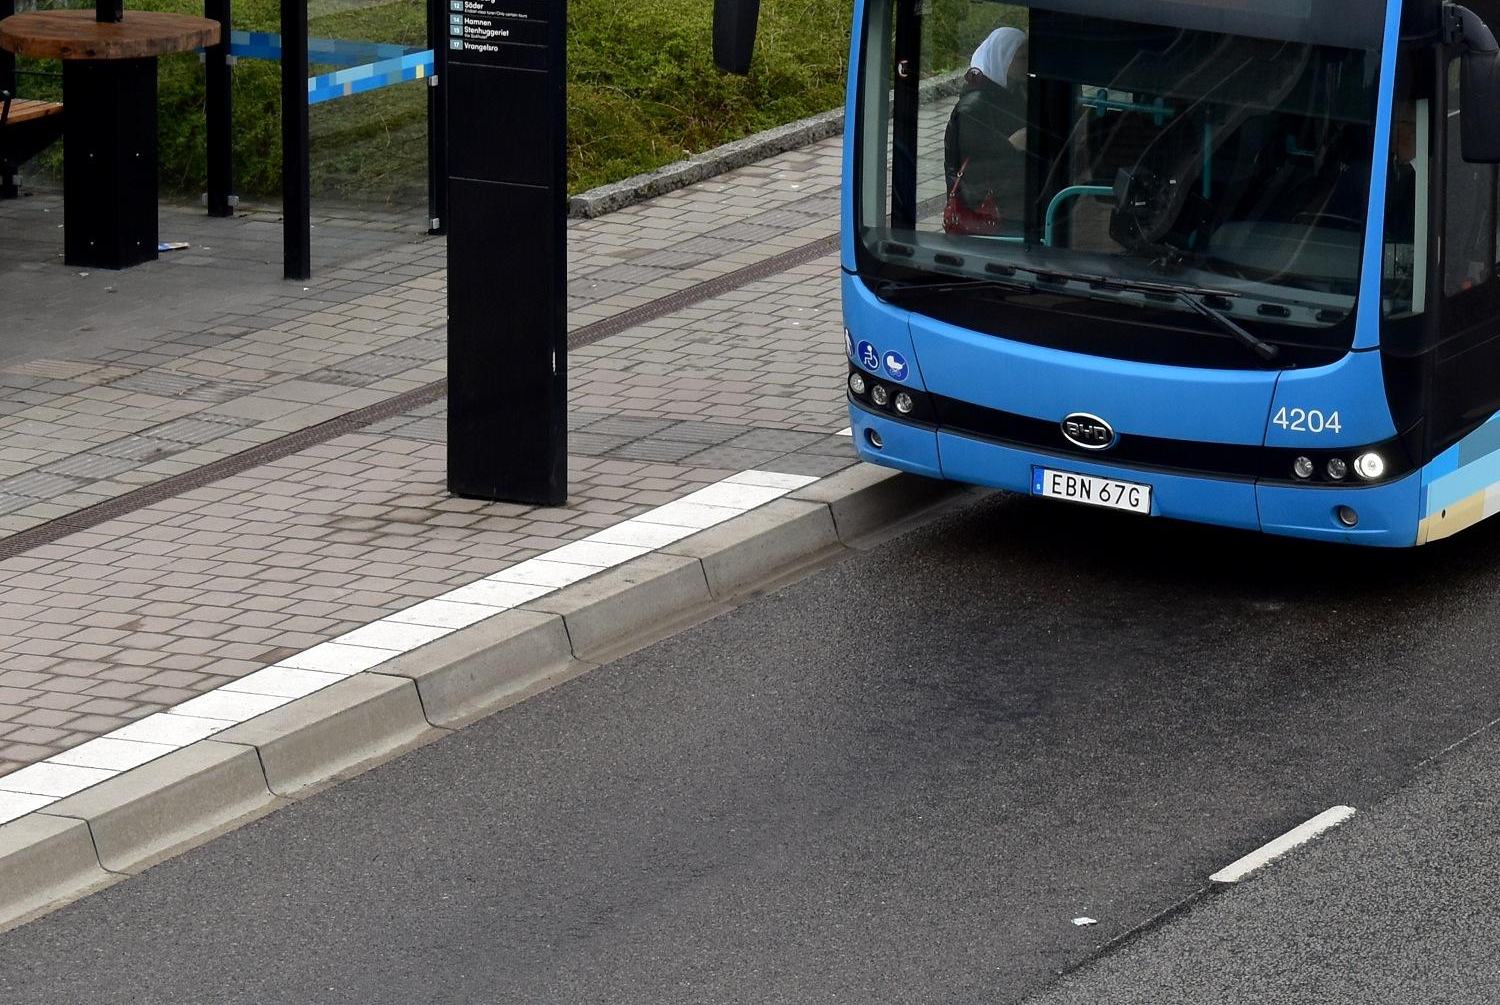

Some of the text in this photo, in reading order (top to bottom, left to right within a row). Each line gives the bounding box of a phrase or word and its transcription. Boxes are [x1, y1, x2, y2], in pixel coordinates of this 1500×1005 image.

[465, 1, 483, 10] Söder
[465, 17, 491, 26] Hamnen
[464, 26, 509, 37] Stenhuggeriet
[464, 42, 498, 52] Vrangelsro
[1273, 406, 1342, 433] 4204
[1066, 421, 1108, 441] BYD
[1052, 473, 1141, 508] EBN 67G
